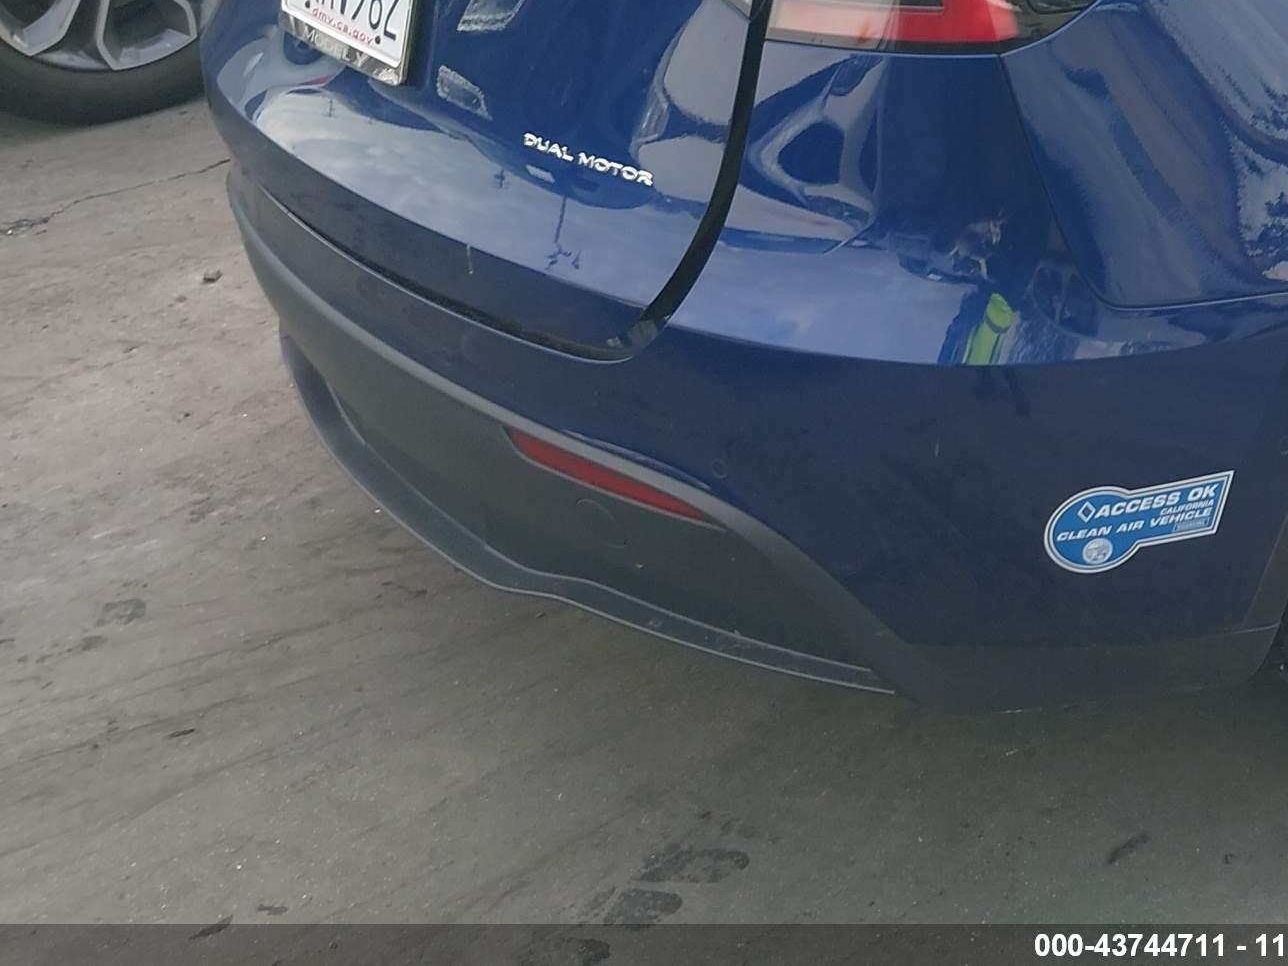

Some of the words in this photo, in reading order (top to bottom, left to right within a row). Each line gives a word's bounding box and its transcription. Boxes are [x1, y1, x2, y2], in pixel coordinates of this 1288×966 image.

[311, 8, 374, 46] dmv.ca.gov
[523, 132, 575, 163] DUAL
[577, 151, 654, 187] MOTOR
[1094, 491, 1180, 519] ACCESS
[1187, 483, 1219, 502] OK
[1159, 499, 1214, 516] CALIFORNIA
[1056, 525, 1112, 542] CLEAN
[1116, 520, 1144, 534] AIR
[1150, 507, 1213, 528] VEHICLE
